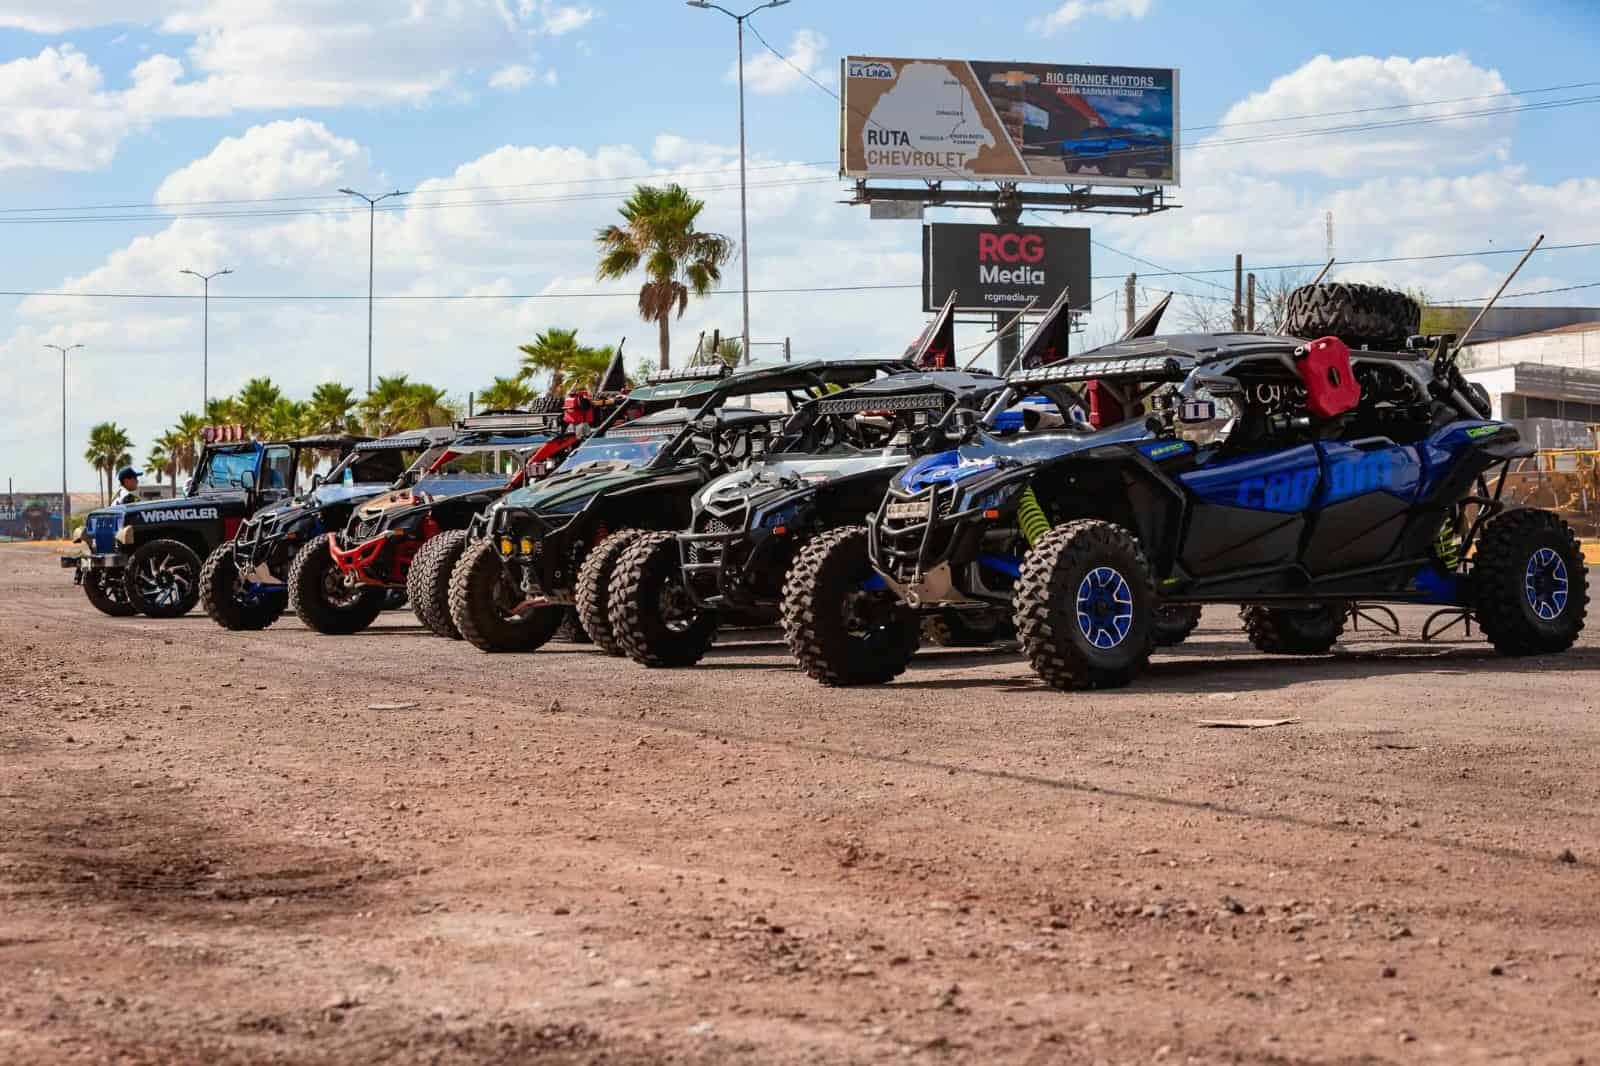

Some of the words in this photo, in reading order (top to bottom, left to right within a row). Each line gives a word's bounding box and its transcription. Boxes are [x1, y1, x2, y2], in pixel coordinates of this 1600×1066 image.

[849, 68, 863, 77] LA
[1046, 72, 1064, 83] RIO
[1066, 73, 1109, 85] GRANDE
[1111, 74, 1154, 87] MOTORS
[867, 129, 911, 147] RUTA
[867, 150, 967, 168] CHEVROLET
[979, 232, 1045, 263] RCG
[980, 265, 1045, 285] Media
[140, 507, 218, 523] WRANGLER
